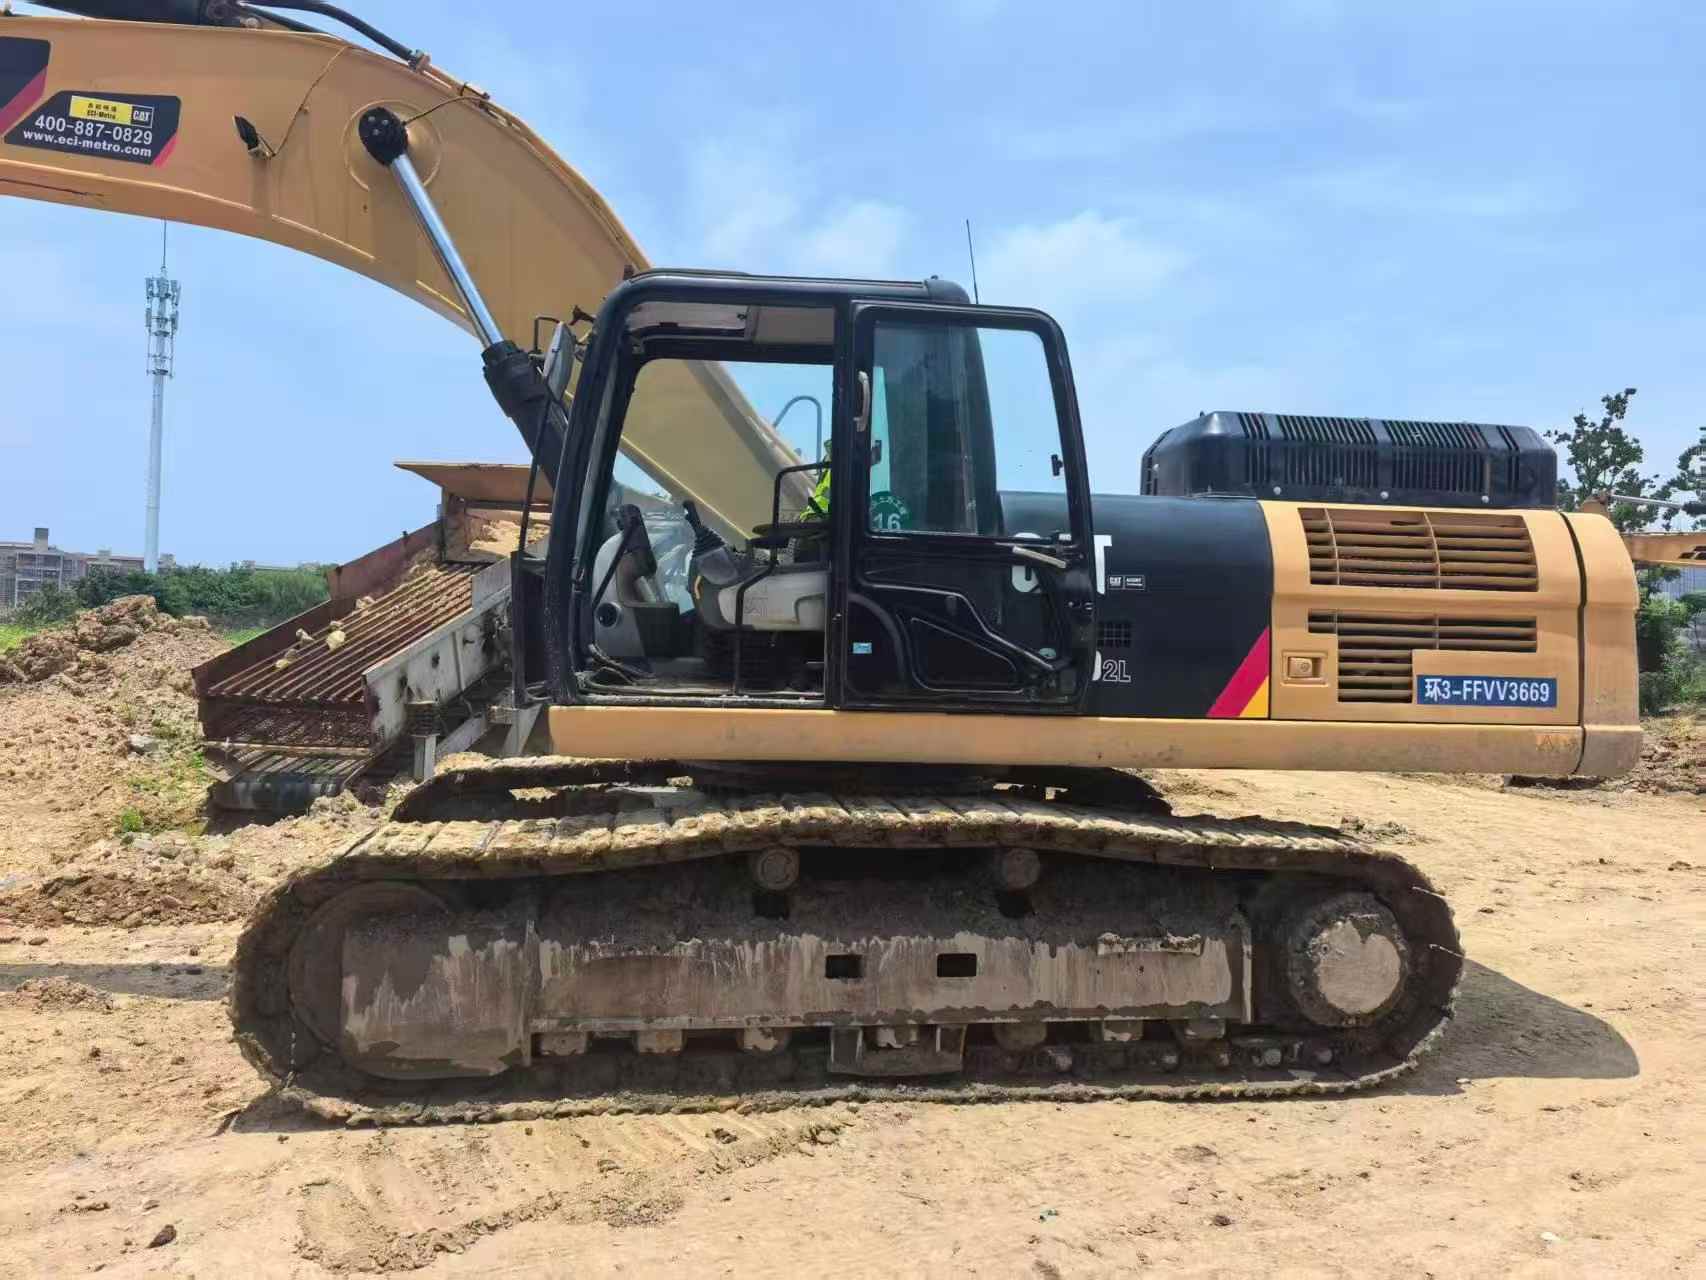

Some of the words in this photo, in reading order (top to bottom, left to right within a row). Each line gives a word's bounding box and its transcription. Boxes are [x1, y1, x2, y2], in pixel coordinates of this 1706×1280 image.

[133, 110, 150, 122] CAT
[35, 114, 153, 145] 400-887-0829
[23, 129, 152, 157] www.eci-metro.com
[1424, 678, 1550, 702] 环3-FFVV3669
